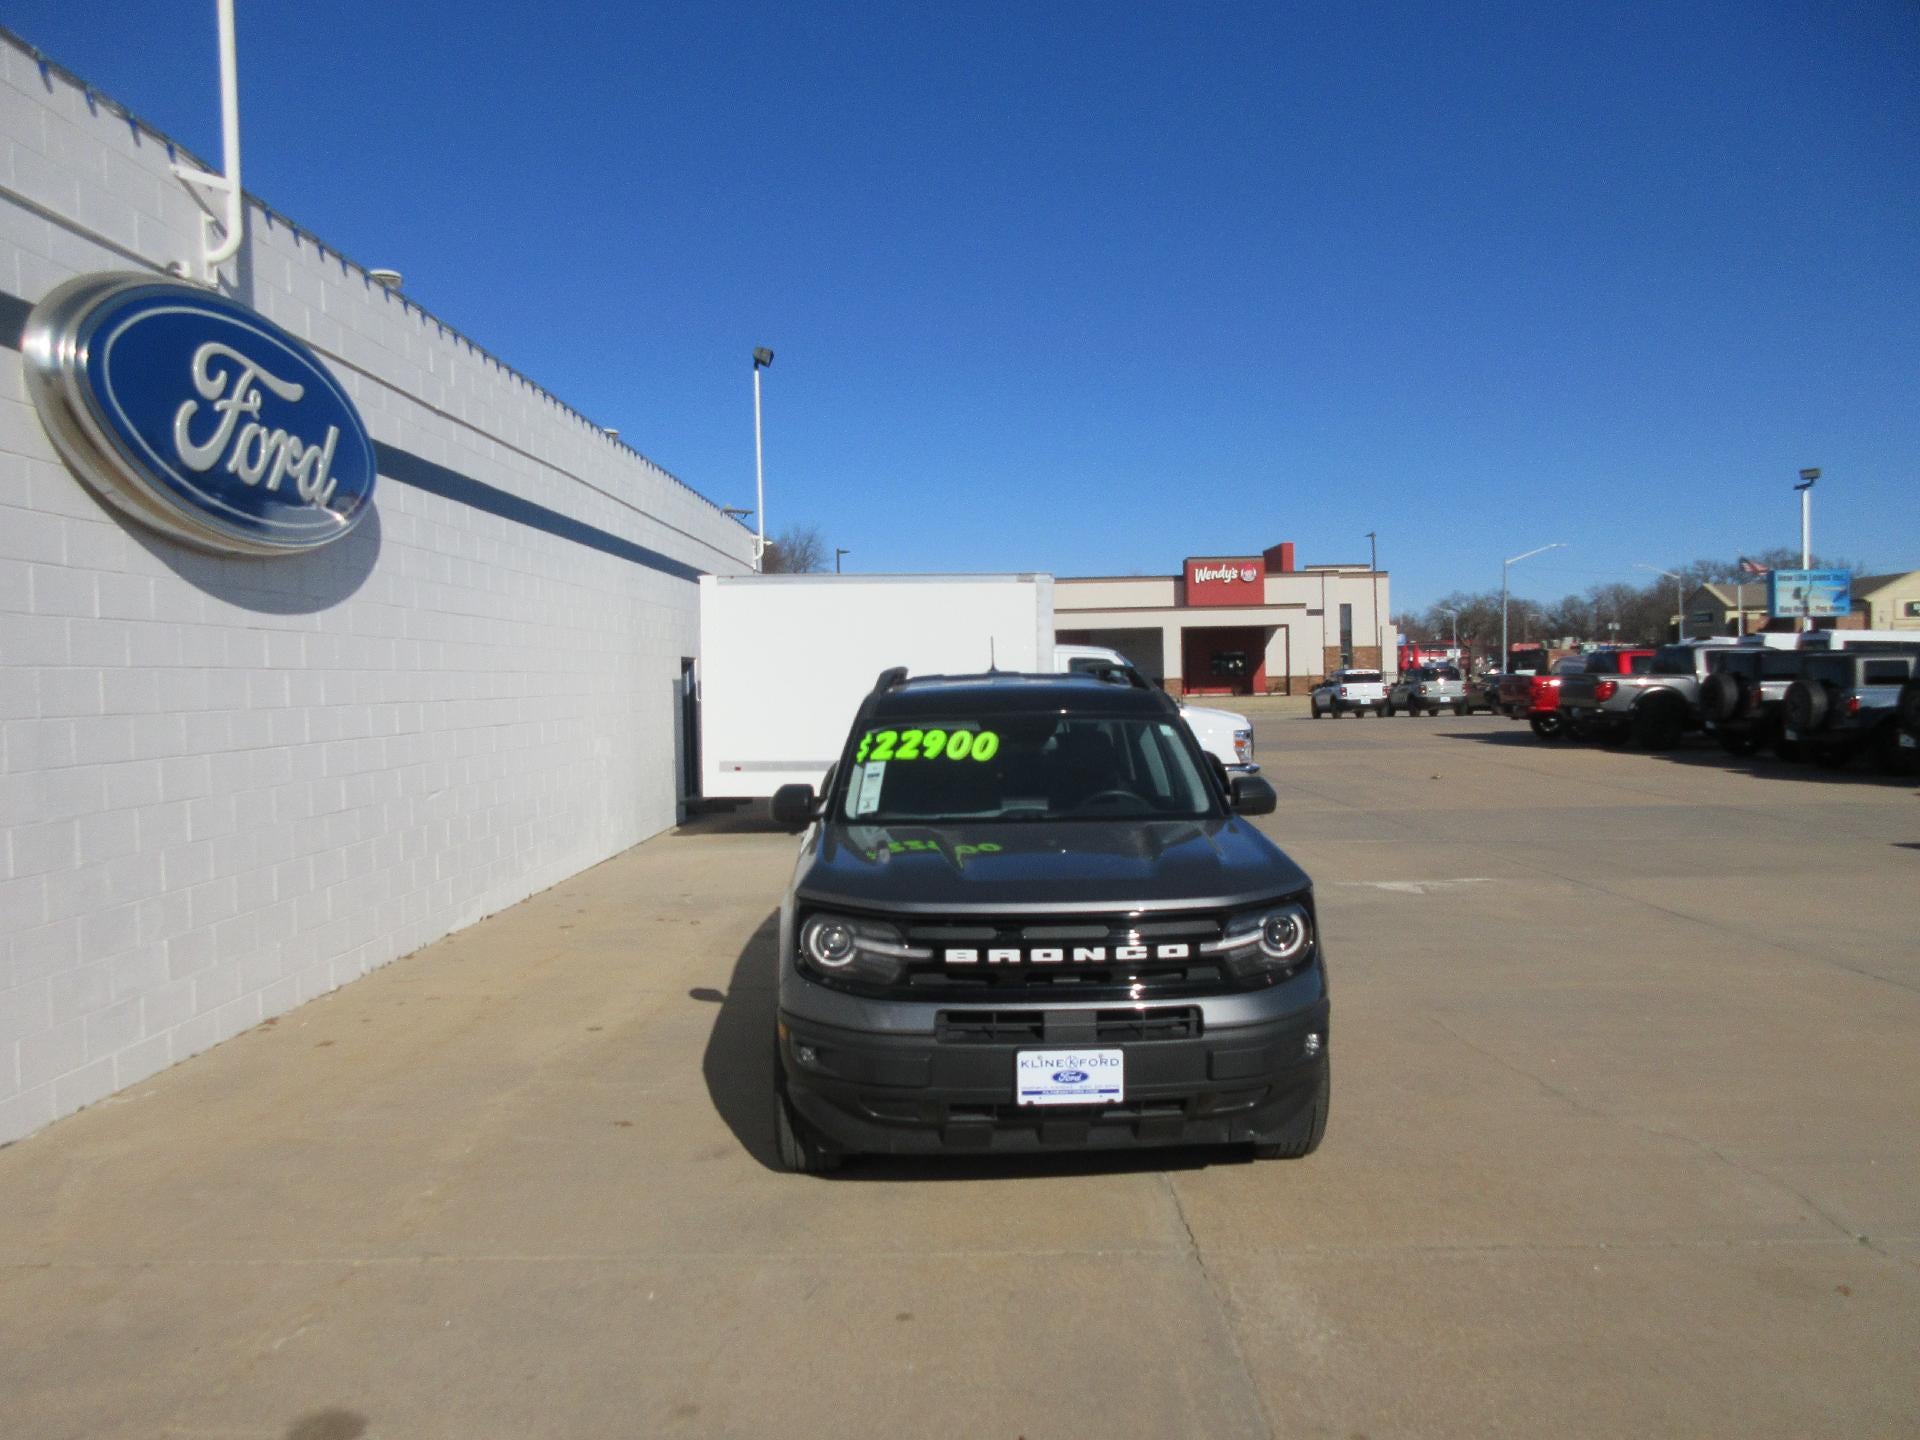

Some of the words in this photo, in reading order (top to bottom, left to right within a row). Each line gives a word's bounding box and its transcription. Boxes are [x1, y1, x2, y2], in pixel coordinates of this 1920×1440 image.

[173, 342, 340, 507] Ford
[1195, 564, 1238, 583] Wendy's
[857, 729, 999, 764] $22900
[945, 944, 1189, 963] BRONCO
[1021, 1059, 1064, 1069] KLINE
[1079, 1058, 1120, 1067] FORD
[1058, 1070, 1082, 1082] Ford
